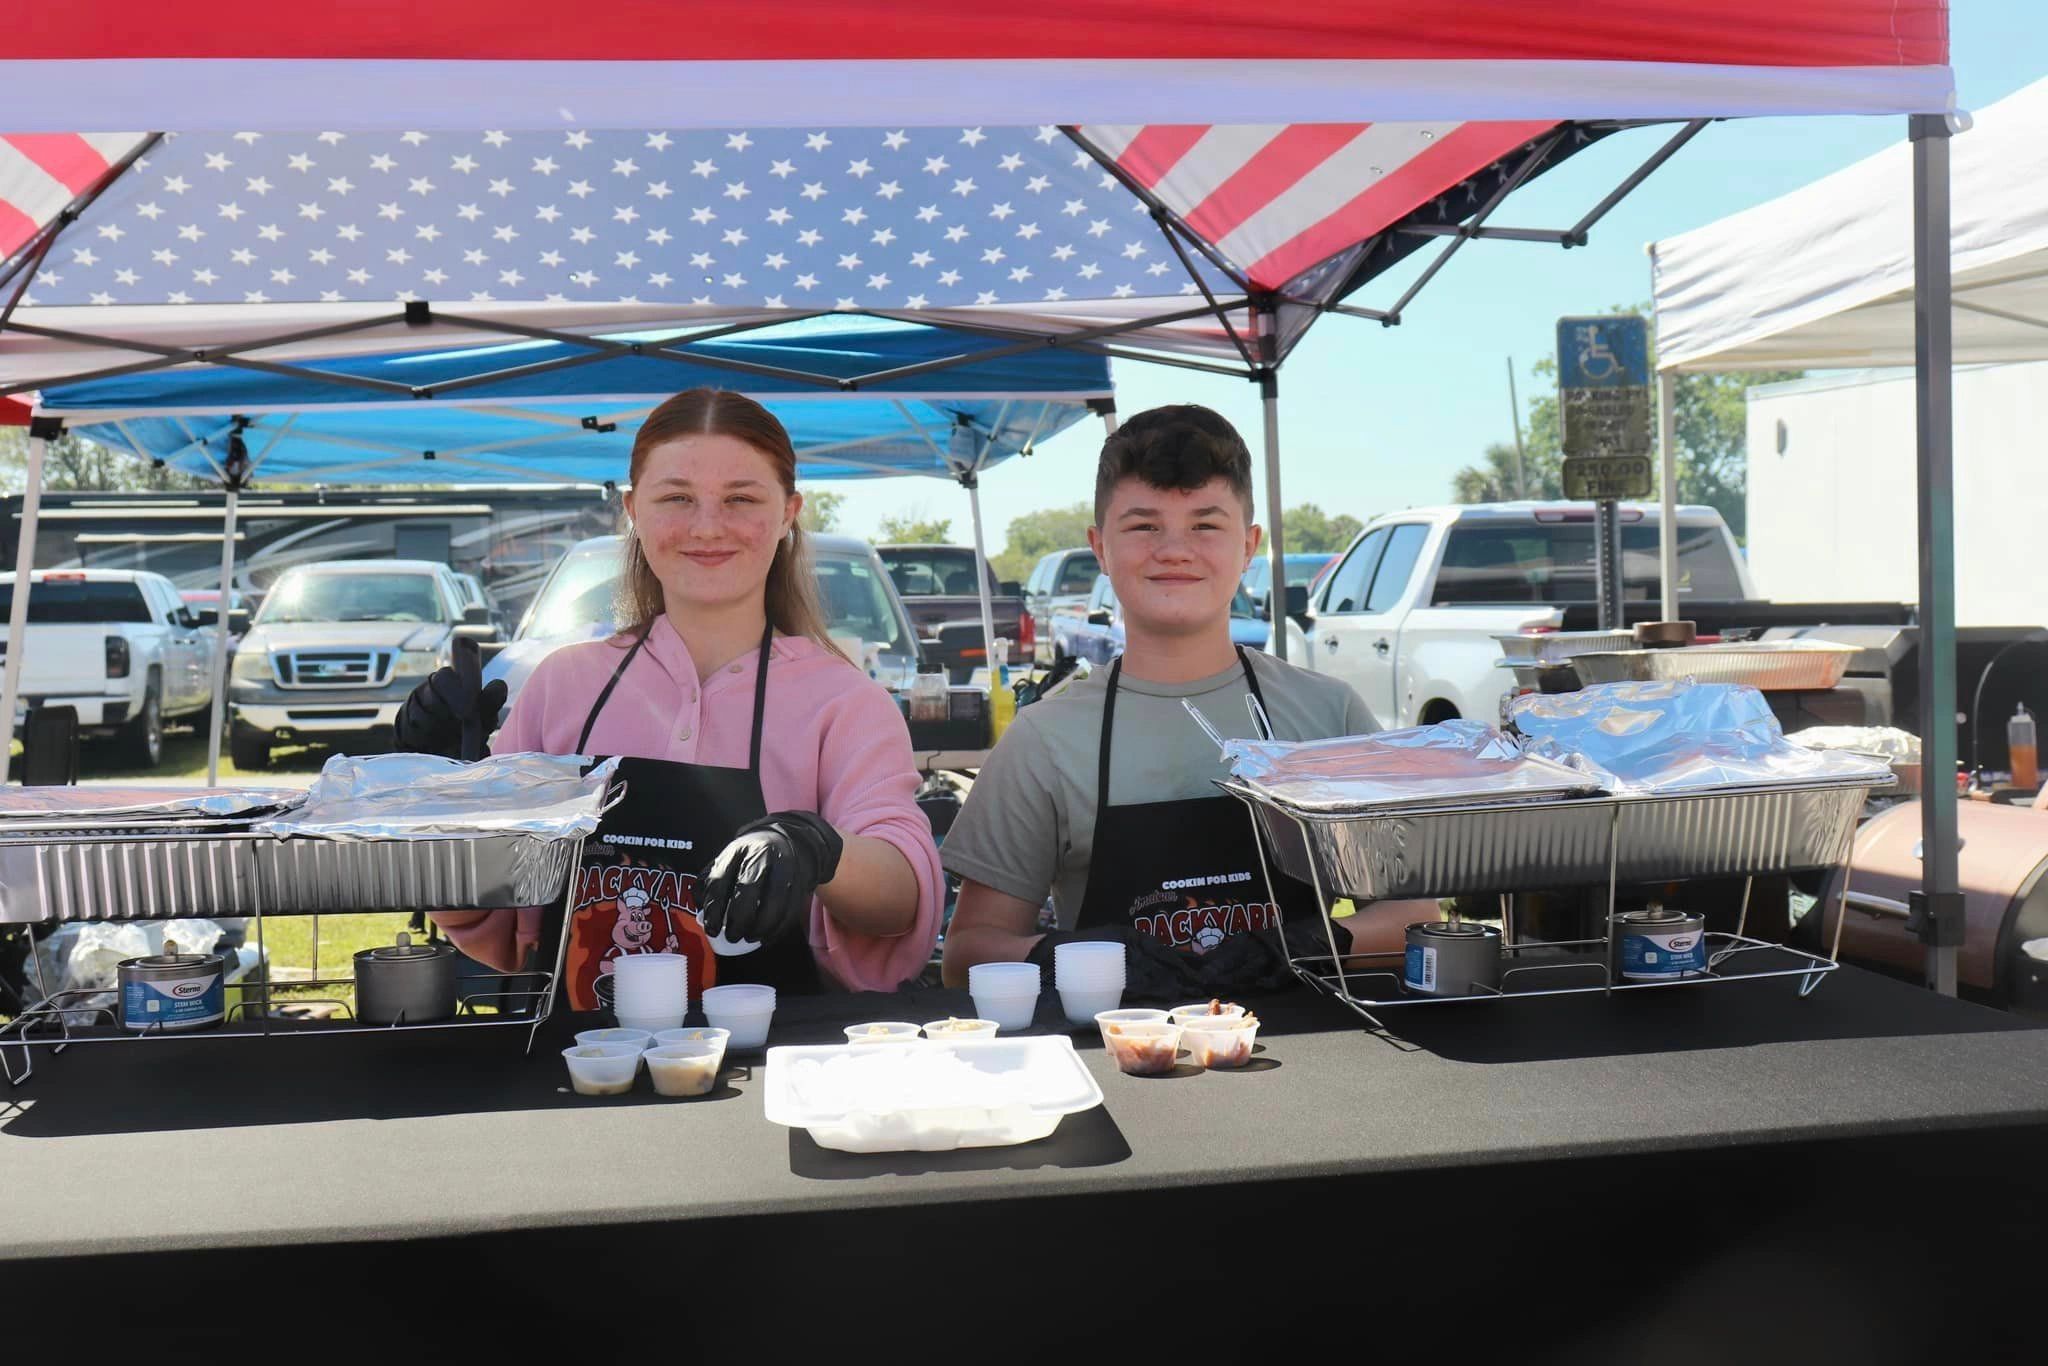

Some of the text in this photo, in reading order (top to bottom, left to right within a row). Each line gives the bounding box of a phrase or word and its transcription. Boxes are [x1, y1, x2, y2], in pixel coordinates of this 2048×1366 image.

[602, 834, 693, 850] COOKIN FOR KIDS
[1162, 872, 1251, 890] COOKIN FOR KIDS
[178, 985, 201, 994] Sterno
